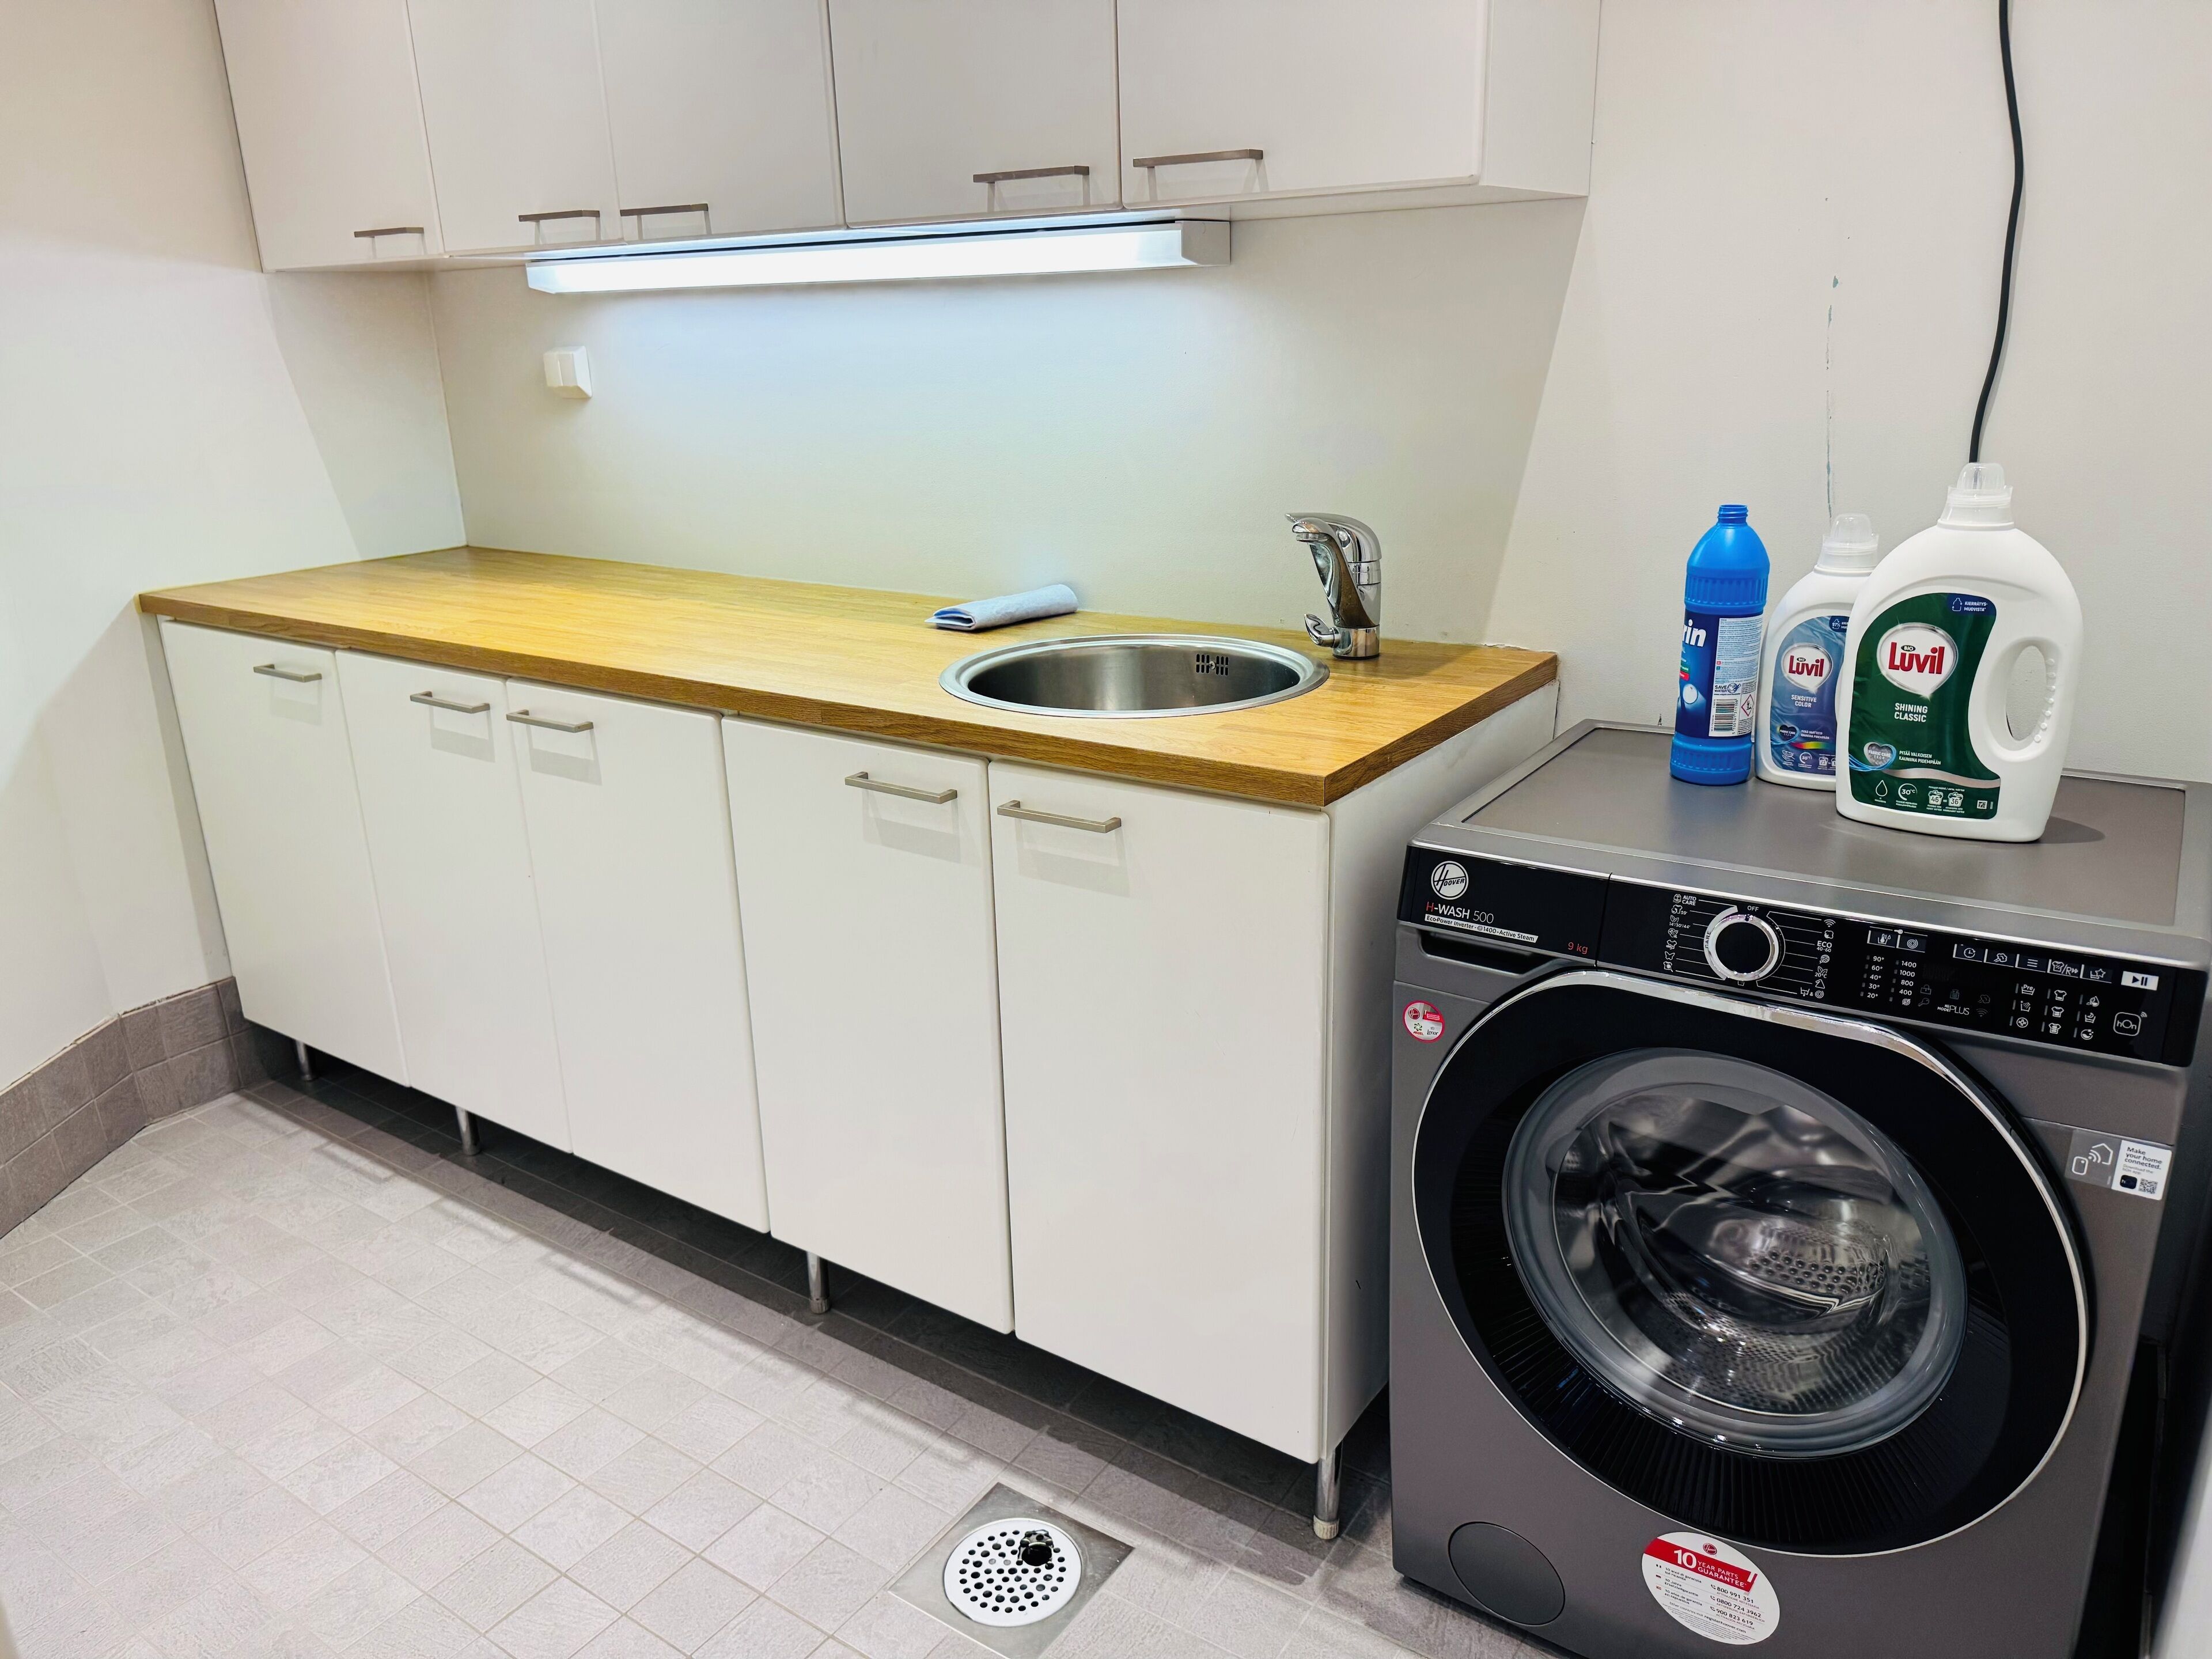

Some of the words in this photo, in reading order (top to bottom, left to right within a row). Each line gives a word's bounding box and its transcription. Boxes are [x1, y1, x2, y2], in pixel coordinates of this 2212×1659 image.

[1888, 642, 1945, 675] Luvil
[1789, 655, 1824, 677] Luvil
[1791, 694, 1817, 702] SENSITIVE
[1895, 703, 1928, 713] SHINING
[1894, 712, 1926, 722] CLASSIC
[1426, 902, 1469, 919] H-WASH
[1473, 911, 1494, 923] 500
[1427, 915, 1453, 925] Eco-Power
[1454, 921, 1474, 929] Inverter
[1517, 933, 1534, 941] Steam
[1568, 942, 1574, 950] 9
[1577, 944, 1588, 955] kg
[1817, 940, 1832, 948] ECO
[1949, 1005, 1969, 1016] PLUS
[2116, 1020, 2137, 1030] hOn
[2127, 1147, 2146, 1155] Make
[2124, 1158, 2161, 1169] connected.
[2143, 1156, 2162, 1164] home
[1674, 1550, 1696, 1569] 10
[1698, 1560, 1715, 1571] YEAR
[1718, 1568, 1738, 1579] PARTS
[1717, 1598, 1732, 1607] 0800
[1733, 1604, 1744, 1612] 724
[1747, 1609, 1761, 1618] 3962
